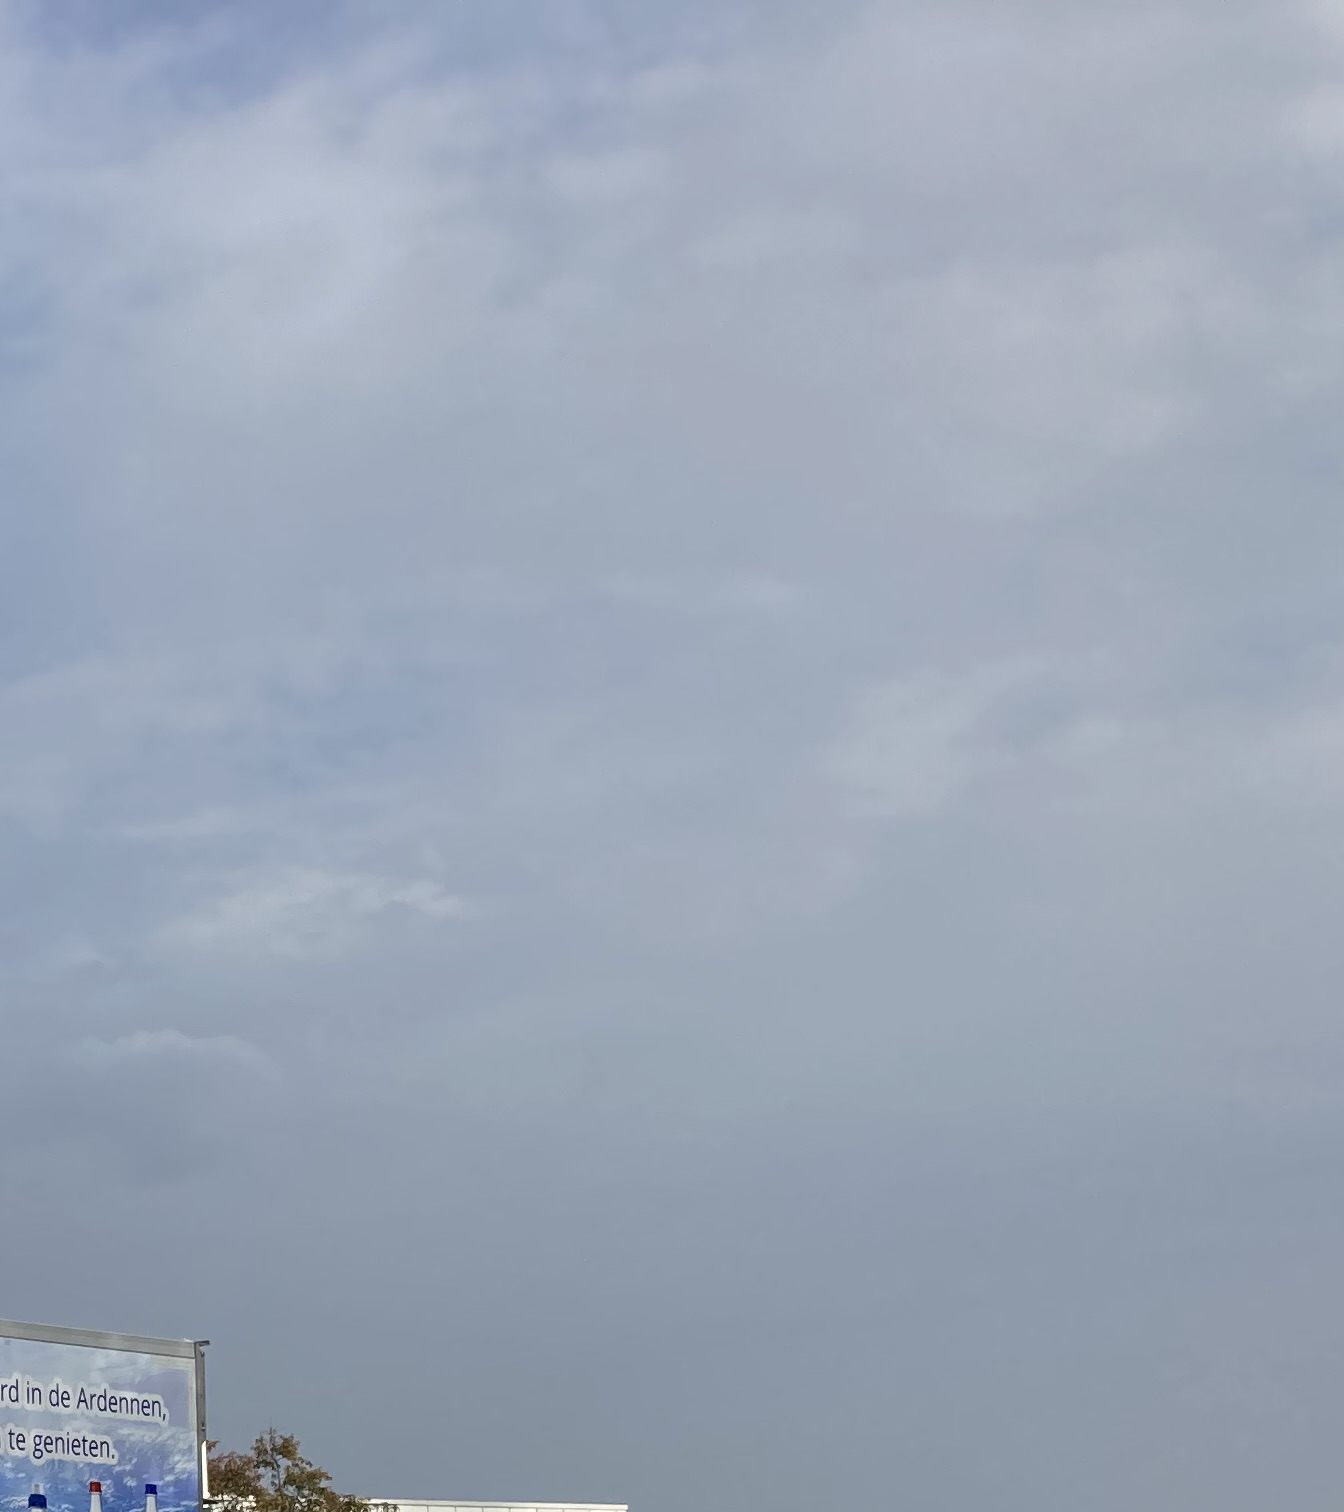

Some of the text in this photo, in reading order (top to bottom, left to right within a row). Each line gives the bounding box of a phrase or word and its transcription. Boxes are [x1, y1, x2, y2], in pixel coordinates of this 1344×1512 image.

[26, 1381, 42, 1405] in
[49, 1383, 71, 1408] de
[77, 1387, 167, 1421] Ardennen,
[8, 1428, 26, 1450] te
[33, 1432, 116, 1459] genieten.
